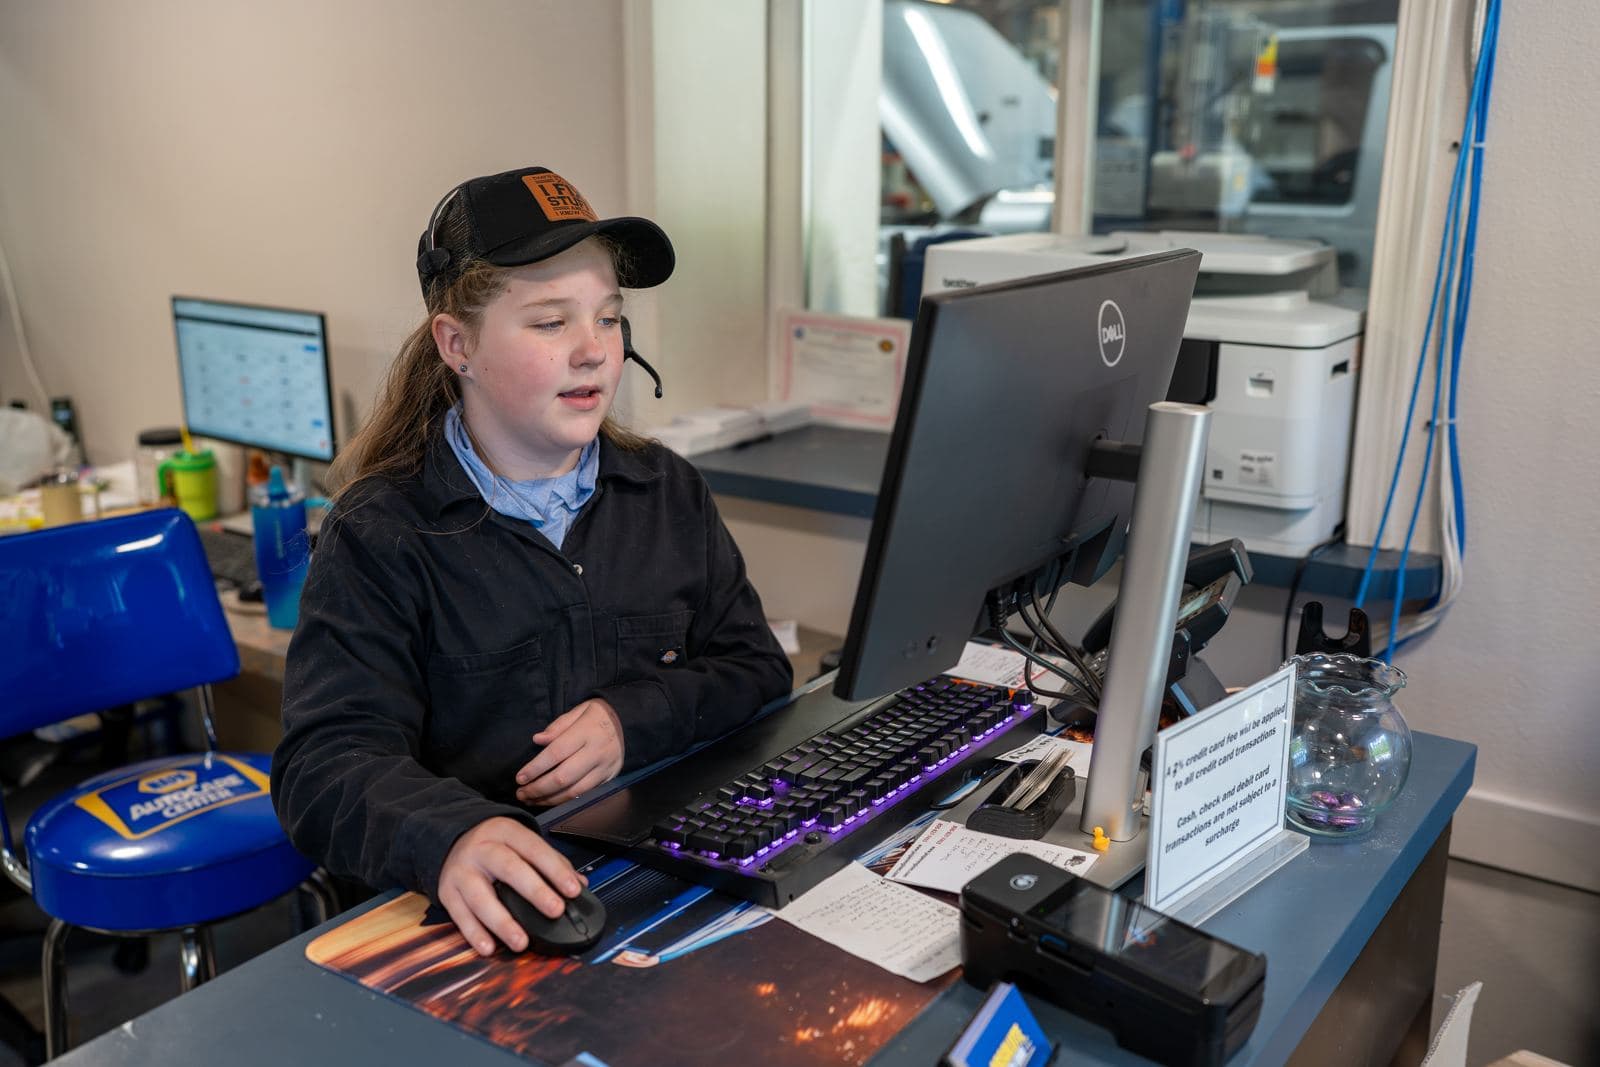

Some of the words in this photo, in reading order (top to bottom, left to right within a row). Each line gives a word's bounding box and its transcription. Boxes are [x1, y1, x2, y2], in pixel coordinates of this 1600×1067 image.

[1102, 323, 1124, 344] DELL
[1174, 780, 1183, 791] to
[1184, 771, 1195, 786] all
[1195, 759, 1217, 779] credit
[1218, 748, 1235, 766] card
[1235, 726, 1277, 757] transactions
[1185, 746, 1208, 767] credit
[1208, 736, 1226, 755] card
[1226, 731, 1239, 746] fee
[1239, 723, 1251, 737] will
[1251, 718, 1261, 730] be
[1261, 703, 1286, 725] applied
[1165, 819, 1212, 853] transactions
[1213, 811, 1226, 824] are
[1226, 800, 1239, 816] not
[1239, 785, 1264, 808] subject
[1264, 781, 1272, 793] to
[1271, 778, 1277, 787] a
[1199, 795, 1221, 815] check
[1221, 785, 1236, 802] and
[1236, 774, 1255, 792] debit
[1254, 764, 1270, 782] card
[1205, 817, 1241, 846] surcharge
